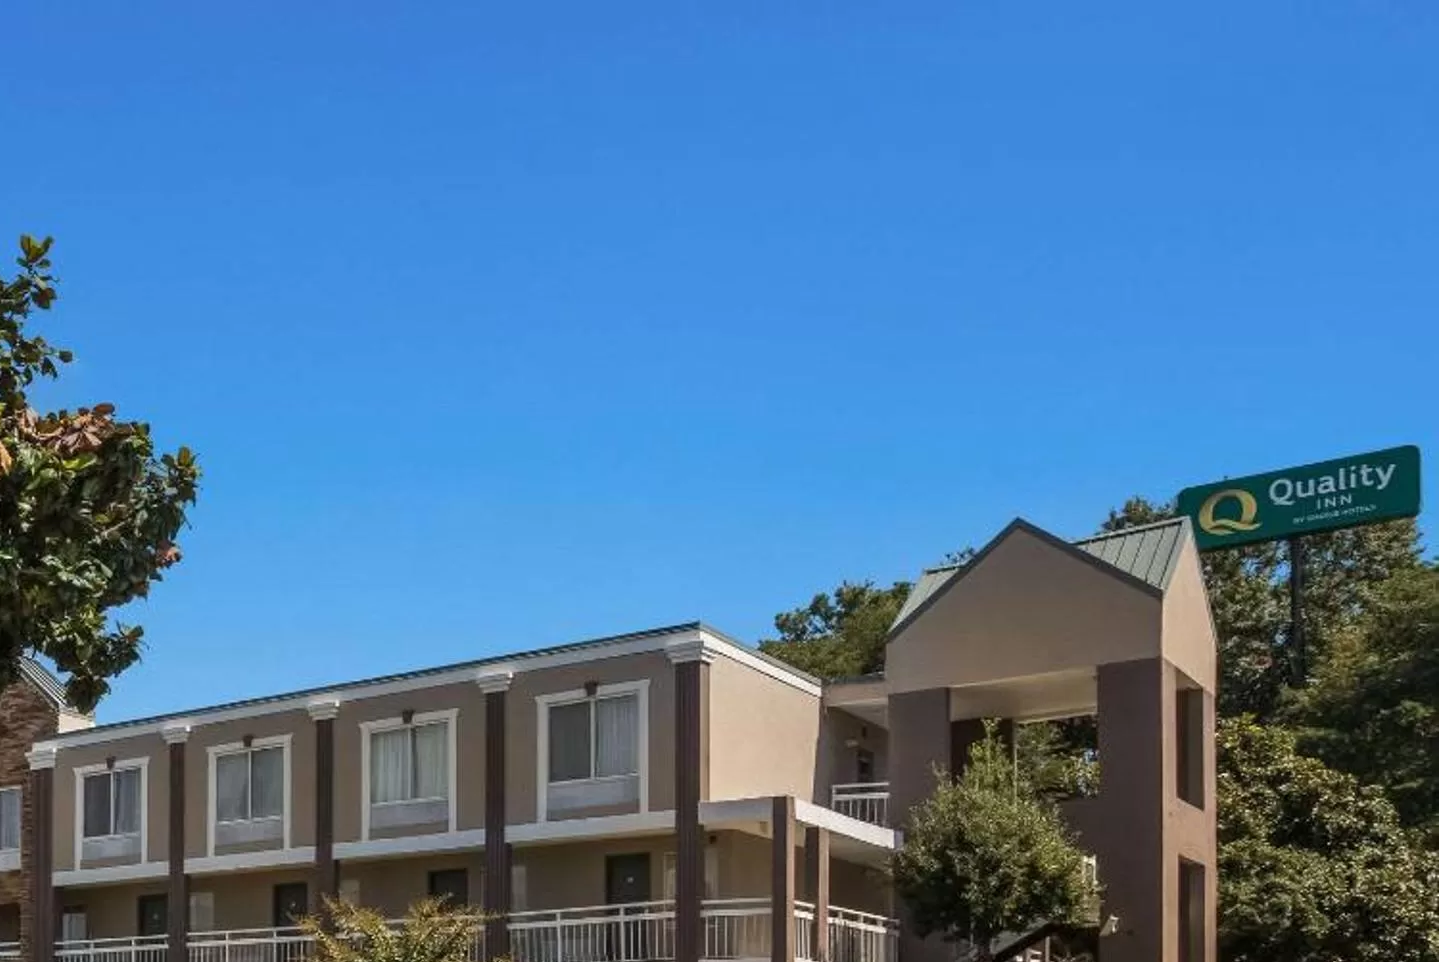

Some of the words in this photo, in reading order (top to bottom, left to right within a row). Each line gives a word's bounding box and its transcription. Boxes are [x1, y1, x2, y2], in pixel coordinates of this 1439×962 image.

[1268, 463, 1397, 506] Quality
[1317, 493, 1352, 510] INN
[1198, 488, 1262, 535] Q
